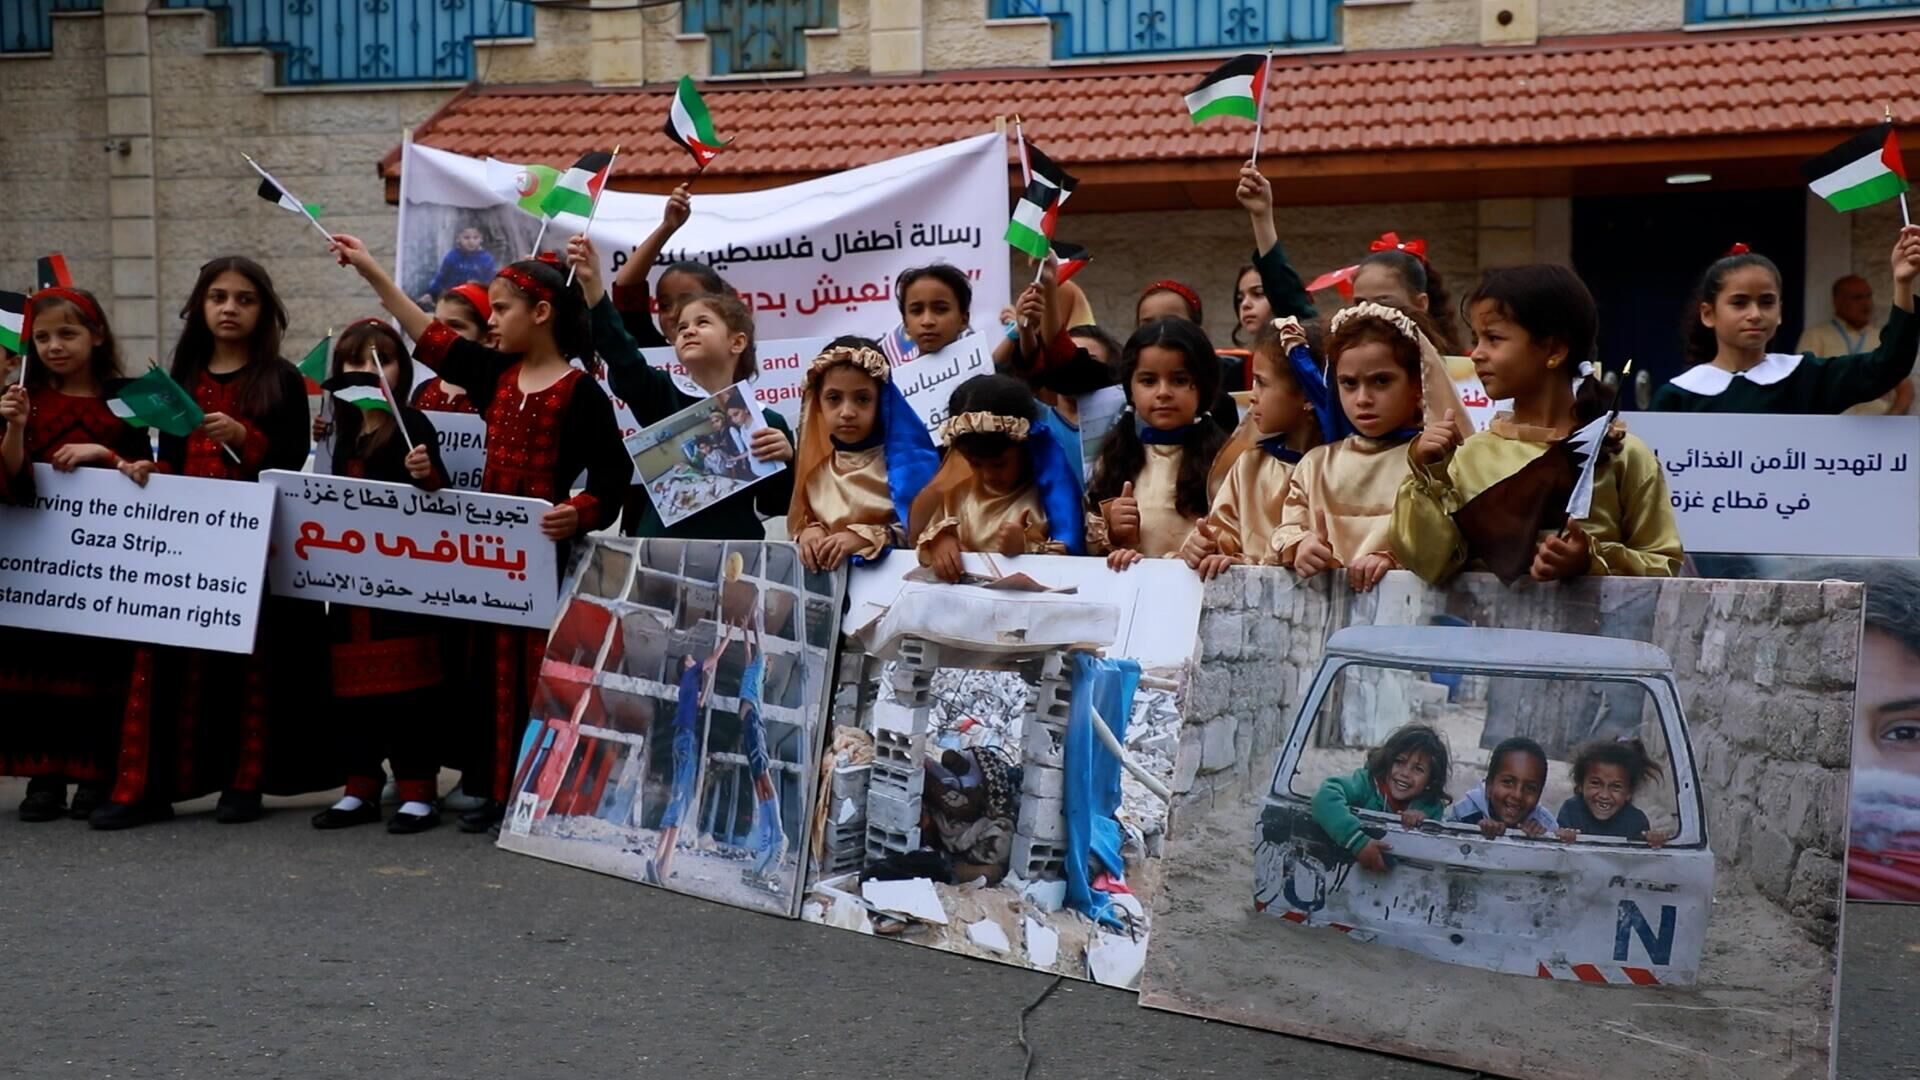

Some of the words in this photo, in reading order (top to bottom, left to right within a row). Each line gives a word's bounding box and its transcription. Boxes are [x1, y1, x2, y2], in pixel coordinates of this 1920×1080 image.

[822, 220, 903, 262] أطفال
[910, 222, 981, 248] رسالة
[796, 273, 890, 315] نعيش
[762, 352, 799, 371] and
[967, 348, 982, 371] لا
[1666, 448, 1743, 477] الغذائي
[1751, 448, 1806, 474] الأمن
[1814, 453, 1882, 476] لتهديد
[1890, 453, 1907, 472] لا
[344, 487, 399, 510] قطاع
[403, 494, 462, 517] أطفال
[1670, 491, 1704, 513] غزة
[1712, 490, 1768, 513] قطاع
[1776, 493, 1810, 519] في
[89, 498, 117, 516] the
[123, 502, 199, 525] children
[205, 510, 226, 527] of
[230, 512, 260, 530] the
[465, 501, 529, 529] تجويع
[71, 528, 116, 549] Gaza
[123, 533, 183, 558] Strip...
[294, 521, 366, 561] مع
[375, 530, 527, 581] يتنافى
[0, 556, 103, 580] contradicts
[109, 565, 138, 583] the
[144, 571, 191, 590] most
[197, 574, 248, 594] basic
[293, 570, 355, 592] الإنسان
[359, 577, 413, 599] حقوق
[420, 587, 477, 606] معايير
[481, 591, 534, 616] أبسط
[93, 596, 113, 613] of
[117, 598, 180, 620] human
[187, 605, 242, 628] rights
[1613, 900, 1677, 966] N
